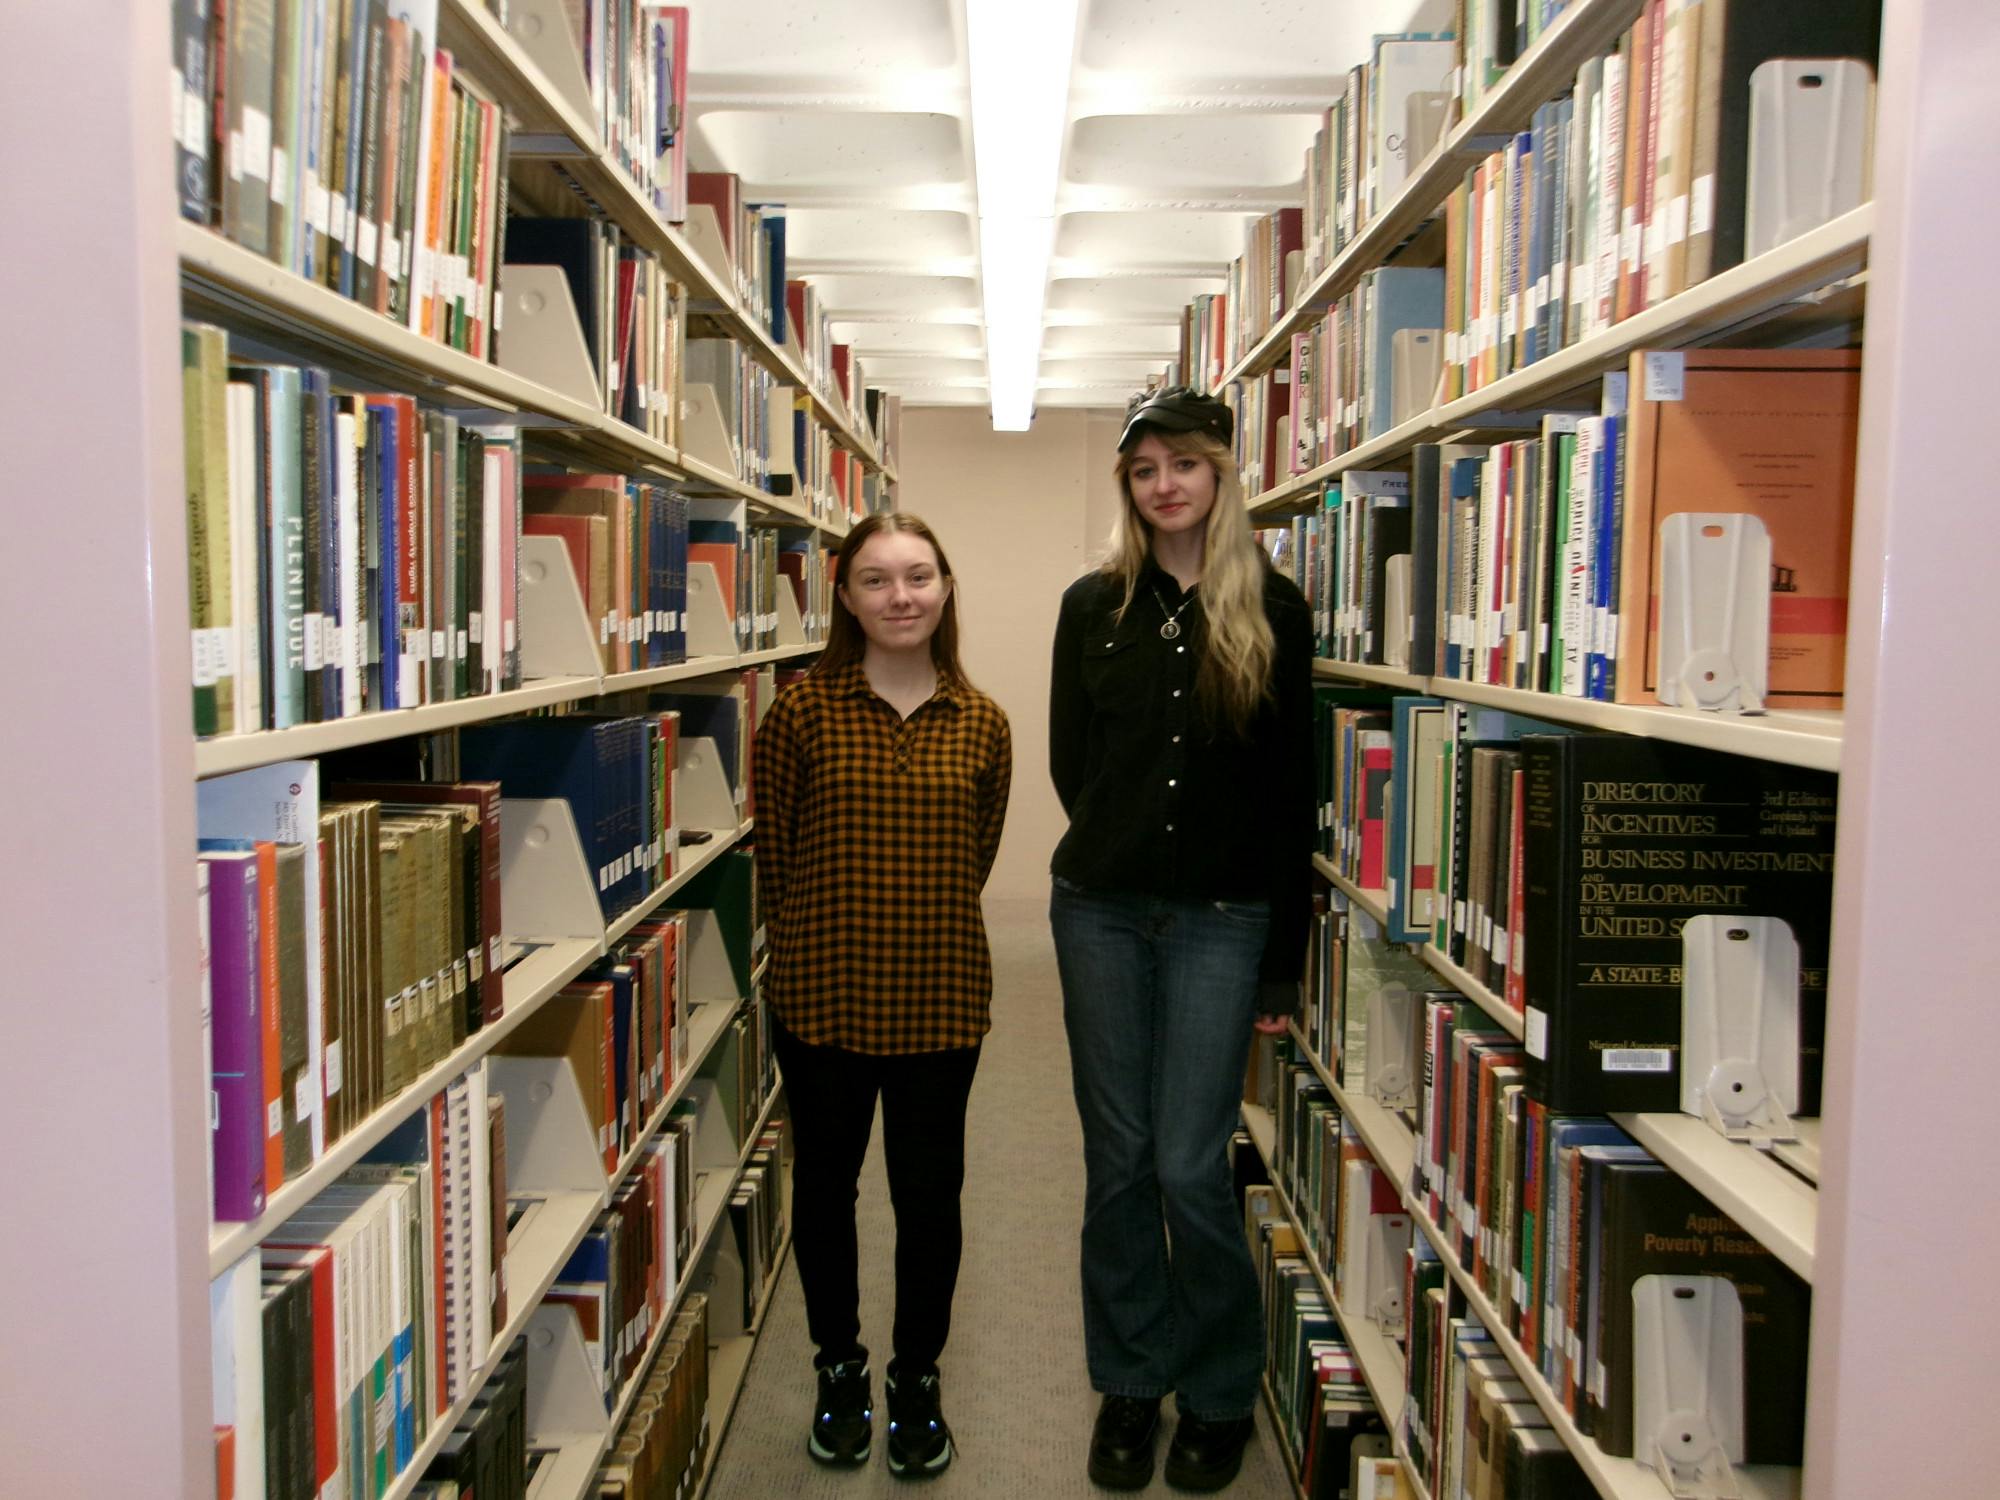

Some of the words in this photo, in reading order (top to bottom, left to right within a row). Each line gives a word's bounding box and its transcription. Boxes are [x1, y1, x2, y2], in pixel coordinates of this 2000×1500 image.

[408, 458, 416, 509] resource
[408, 510, 417, 558] property
[408, 560, 417, 595] rights
[286, 516, 304, 670] PLENITUDE
[1582, 782, 1706, 802] DIRECTORY
[1761, 791, 1784, 806] 3rd
[1580, 804, 1595, 813] OF
[1582, 813, 1716, 834] INCENTIVES
[1581, 835, 1601, 845] FOR
[1582, 849, 1686, 870] BUSINESS
[1580, 873, 1605, 883] AND
[1581, 883, 1747, 904] DEVELOPMENT
[1580, 906, 1592, 915] IN
[1593, 906, 1615, 915] THE
[1581, 917, 1664, 936] UNITED
[1589, 967, 1604, 983] A
[1644, 1233, 1707, 1256] Poverty
